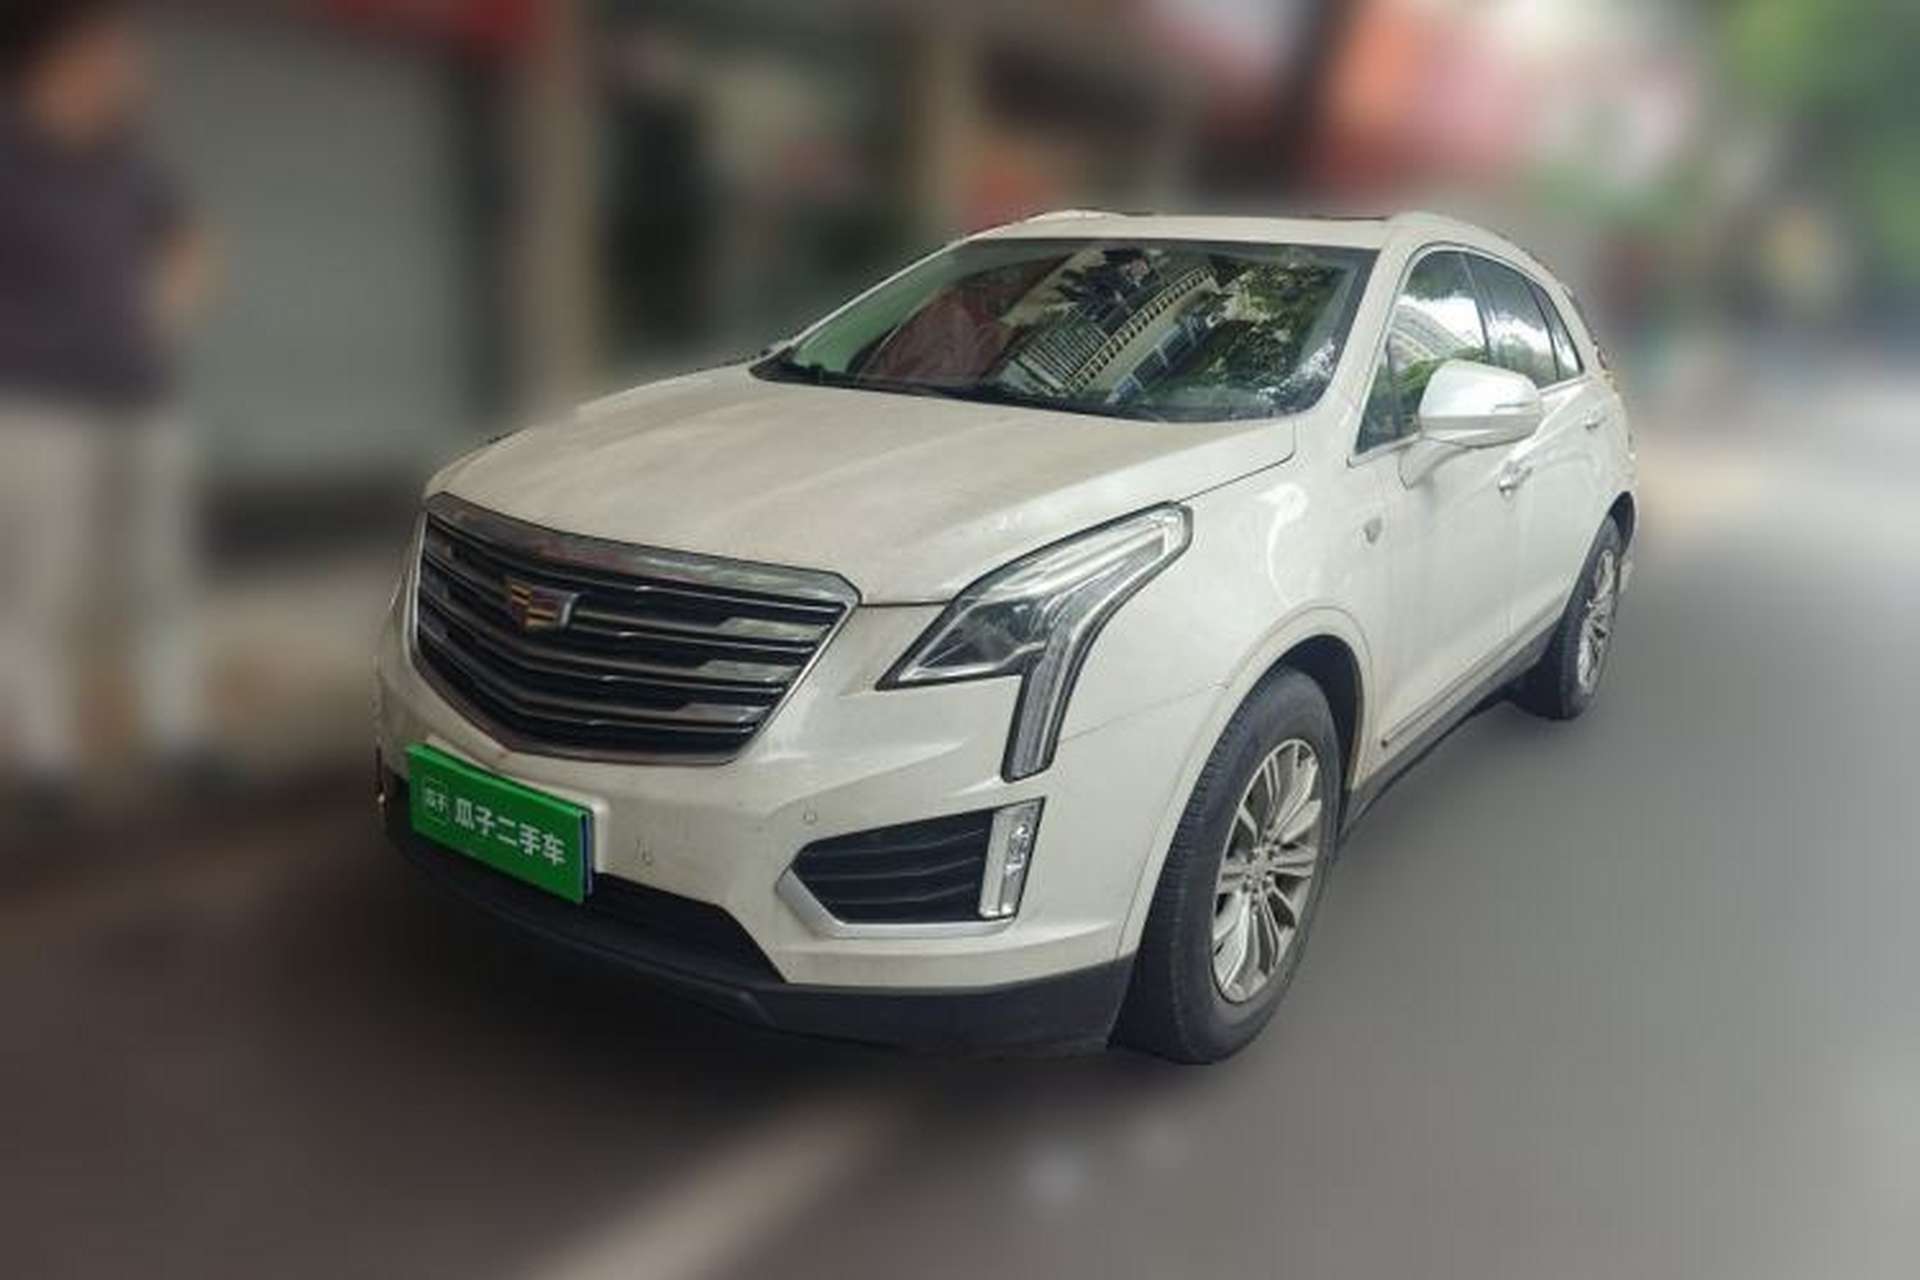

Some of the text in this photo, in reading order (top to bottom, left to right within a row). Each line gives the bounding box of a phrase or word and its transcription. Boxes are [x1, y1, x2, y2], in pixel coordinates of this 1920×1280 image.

[454, 797, 567, 866] 瓜子二手车
